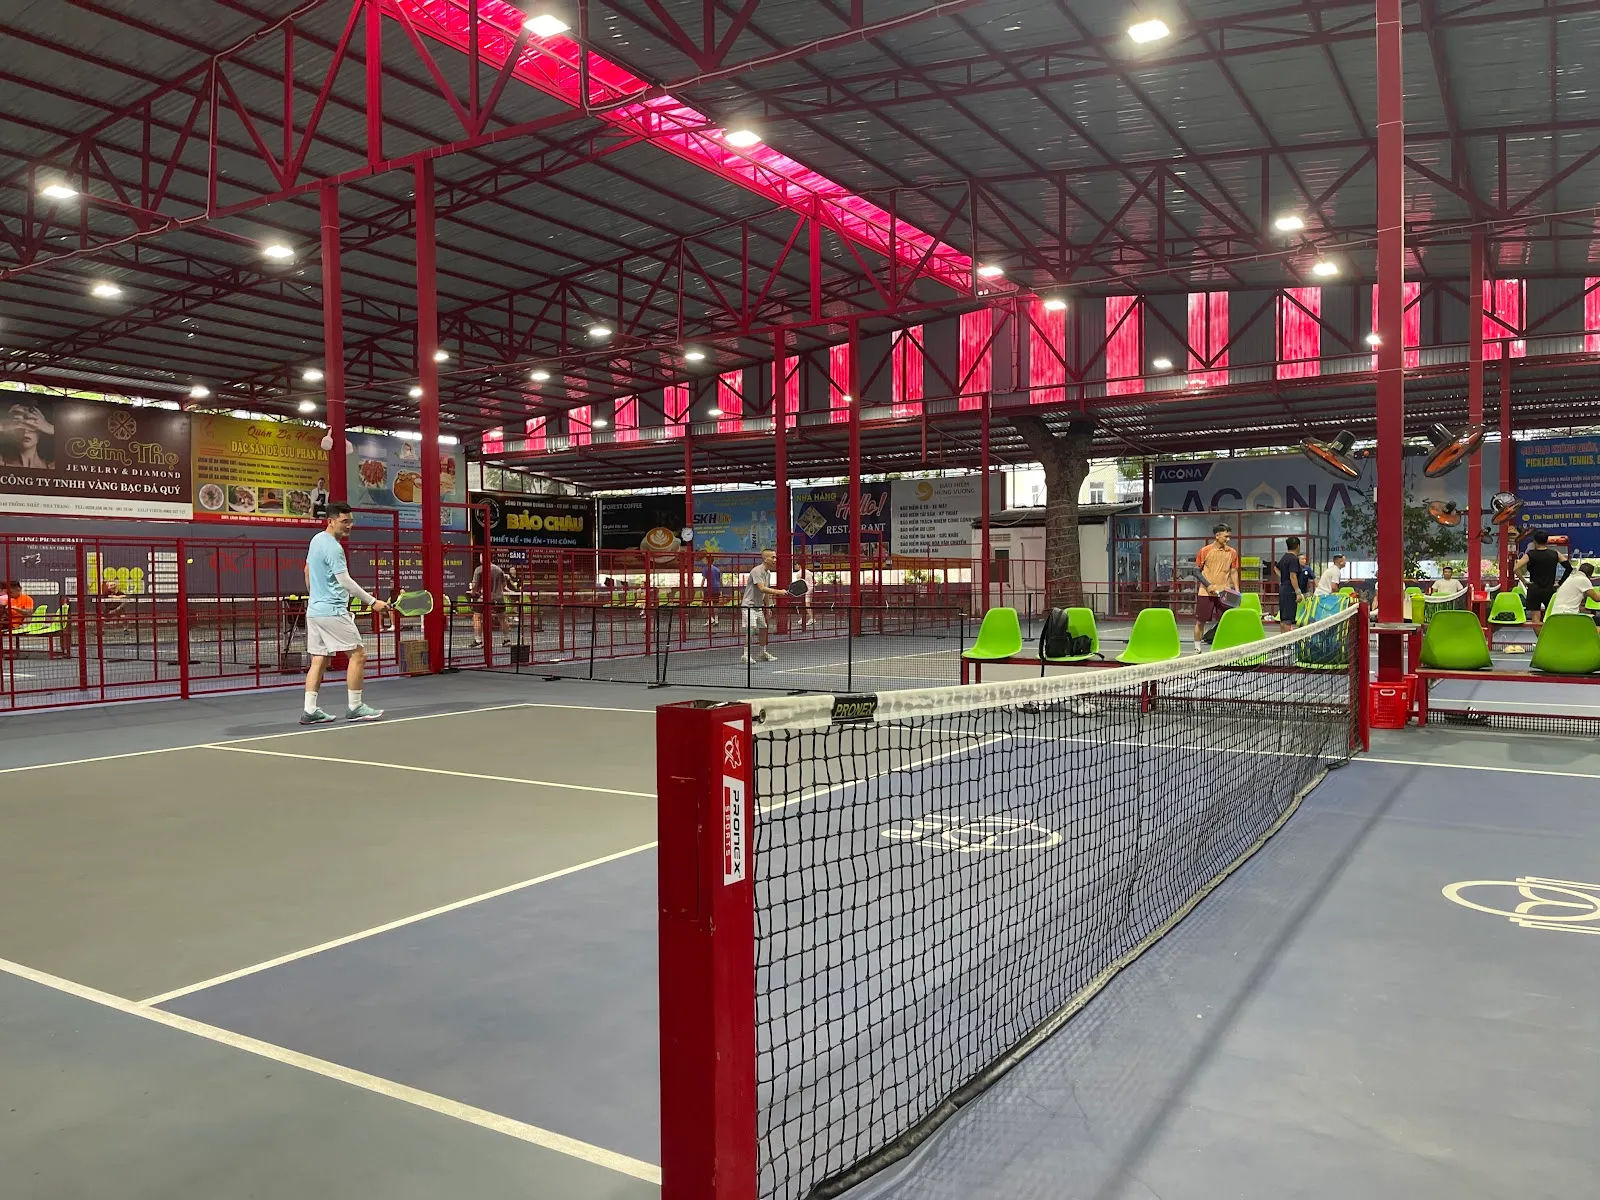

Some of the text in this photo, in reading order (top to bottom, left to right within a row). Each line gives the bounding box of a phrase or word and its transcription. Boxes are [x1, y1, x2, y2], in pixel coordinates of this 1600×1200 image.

[231, 441, 248, 455] ĐẶC
[1526, 455, 1595, 467] PICKLEBALL, TENNIS,
[66, 464, 119, 474] JEWELRY
[132, 469, 181, 479] DIAMOND
[1159, 468, 1202, 480] ACONA
[0, 474, 181, 495] CÔNG TY TNHH VÀNG BẠC ĐÁ QUÝ
[814, 491, 836, 500] HÀNG
[1182, 481, 1352, 512] ACONA
[835, 487, 887, 520] Hllo!
[507, 509, 584, 532] BẢO CHÂU
[826, 523, 886, 534] RESTRANT
[490, 535, 508, 543] THIẾT
[835, 702, 875, 718] PRONEX
[732, 790, 740, 877] PRONEX
